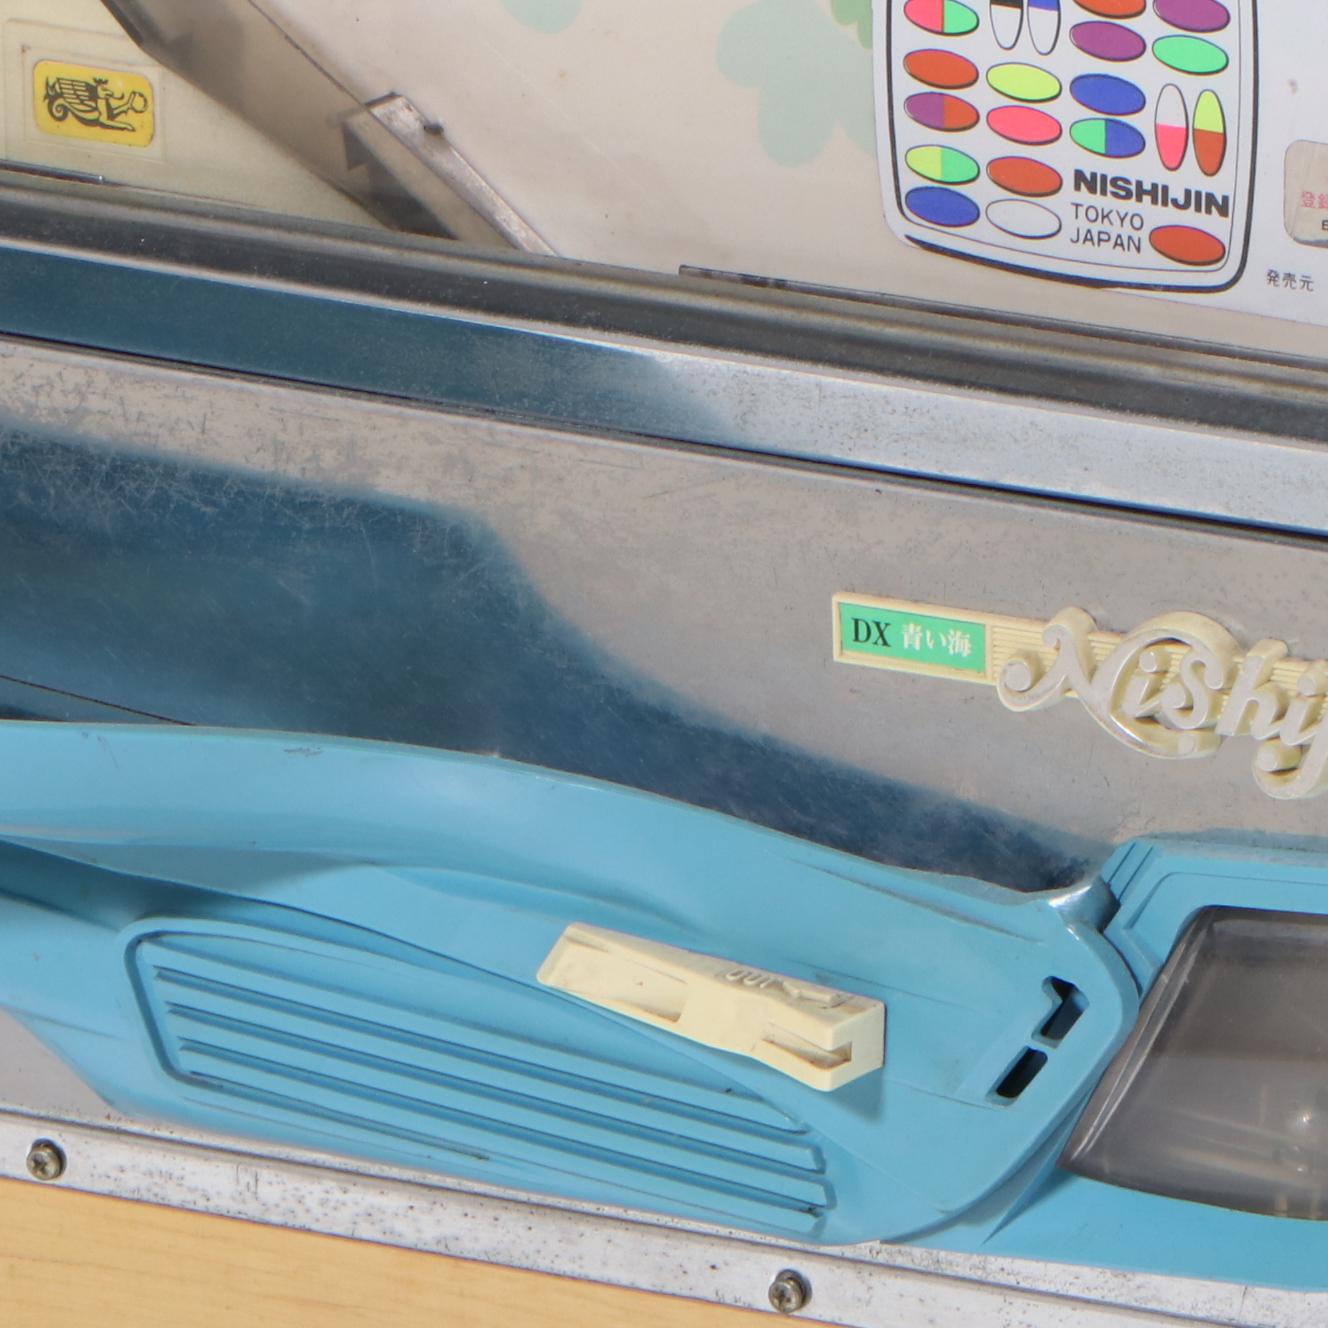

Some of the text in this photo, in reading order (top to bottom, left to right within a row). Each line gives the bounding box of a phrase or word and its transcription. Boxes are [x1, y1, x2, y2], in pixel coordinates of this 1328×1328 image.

[1074, 169, 1229, 218] NISHIJIN
[1071, 203, 1144, 231] TOKYO
[1070, 228, 1141, 254] JAPAN
[1266, 269, 1314, 292] 発売元
[851, 617, 972, 658] DX 青い海
